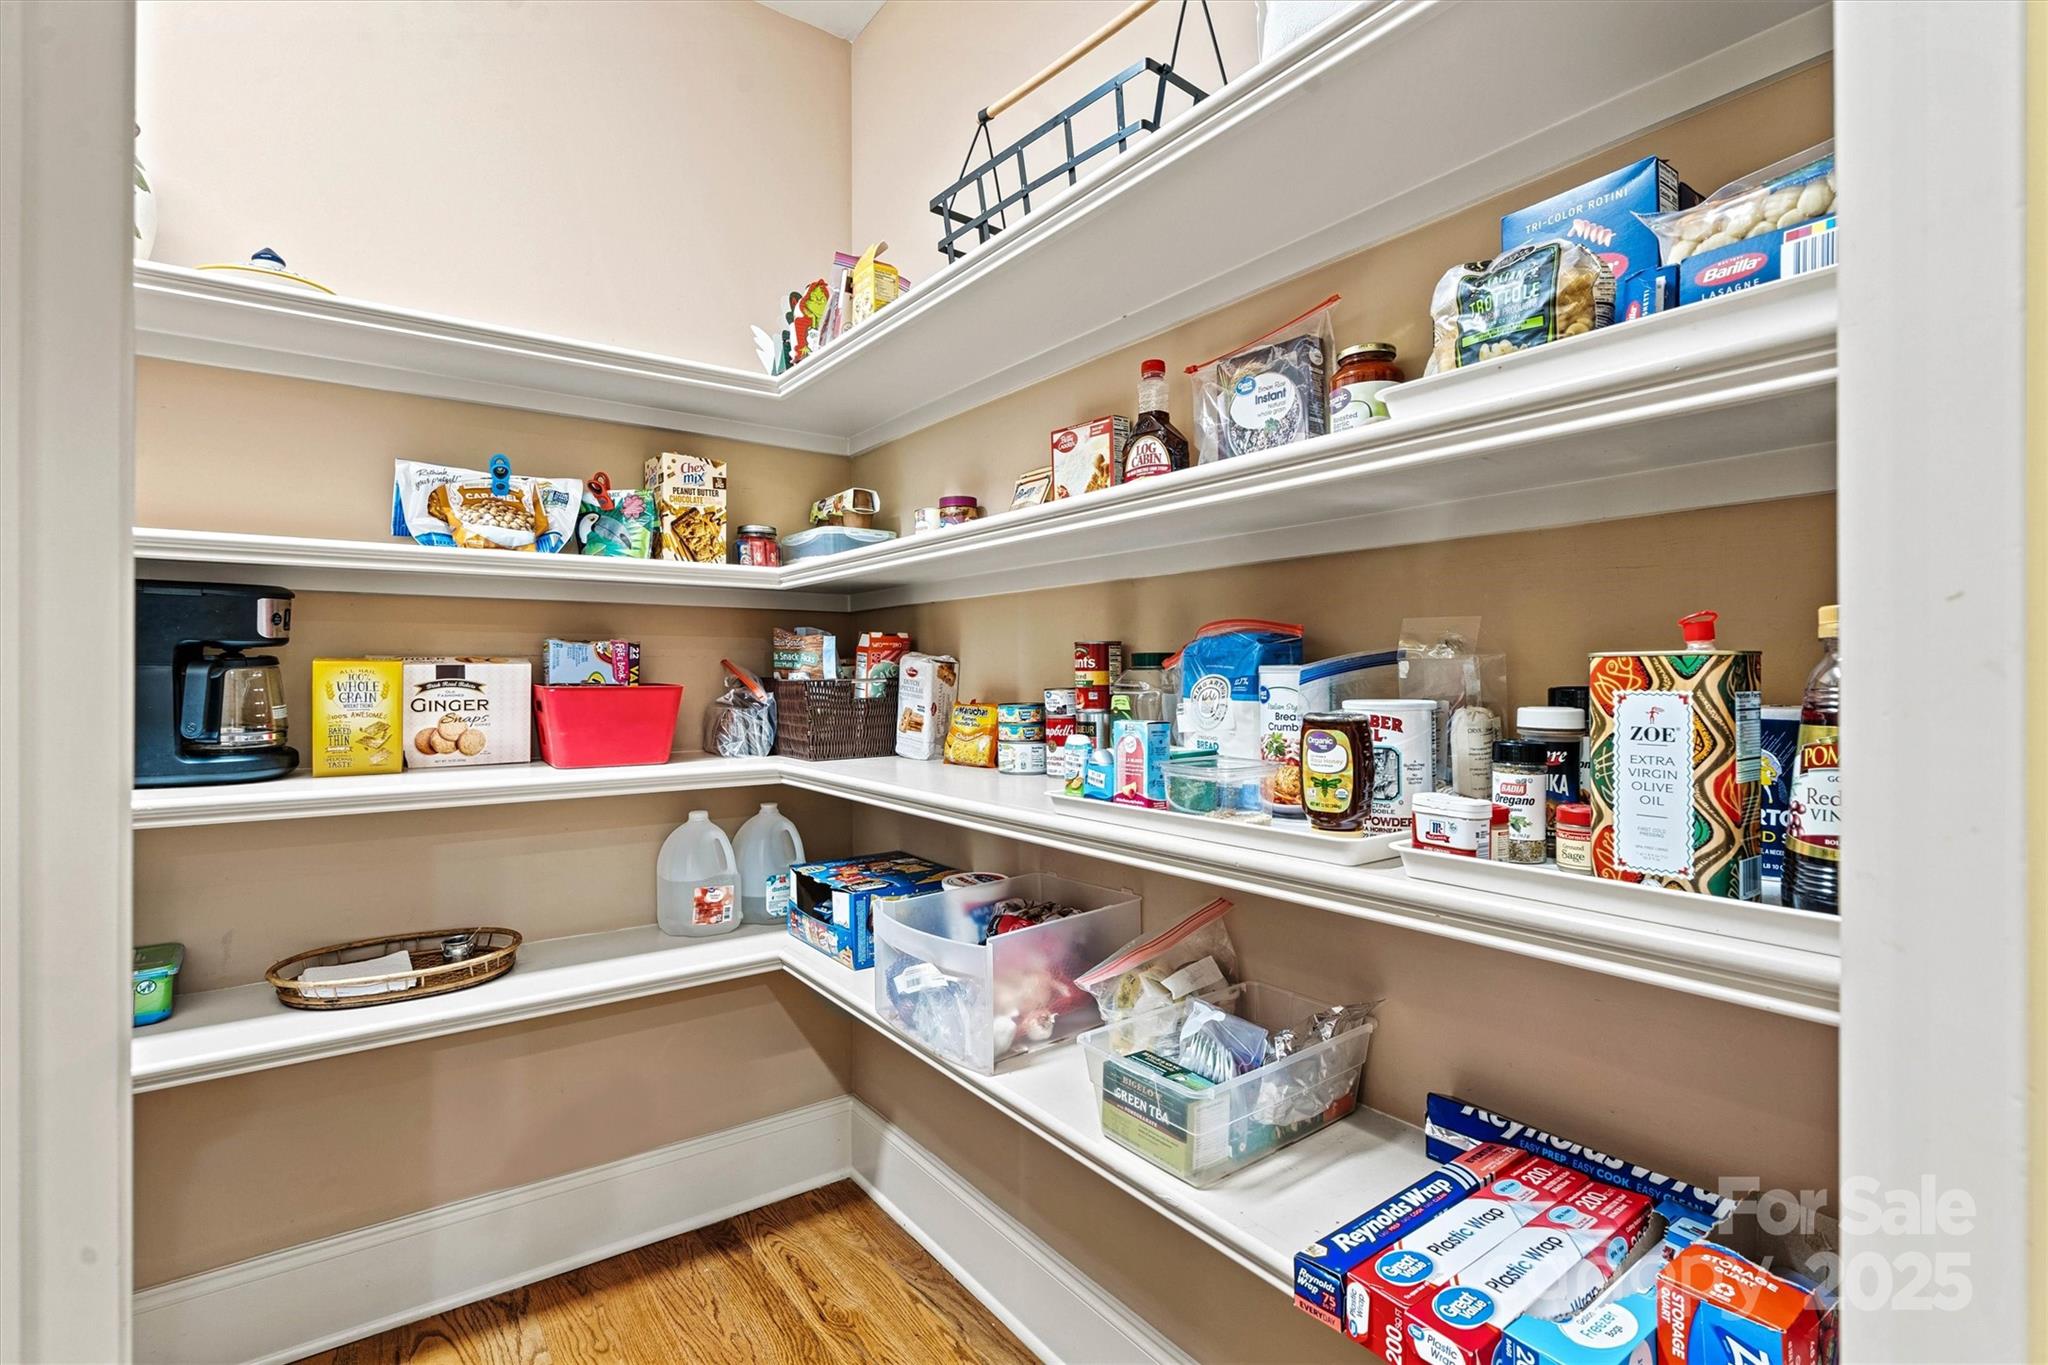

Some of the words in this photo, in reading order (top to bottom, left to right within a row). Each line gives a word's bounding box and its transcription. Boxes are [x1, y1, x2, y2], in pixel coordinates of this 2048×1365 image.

[1525, 204, 1583, 234] TRI-COLOR
[1588, 188, 1628, 210] ROTINI
[1703, 257, 1758, 284] Barilla
[1701, 277, 1760, 301] LASAGNE
[1255, 389, 1287, 405] Instant
[1136, 442, 1157, 456] LOG
[680, 462, 704, 474] Chex
[1131, 452, 1162, 468] CABIN
[683, 472, 704, 485] mix
[465, 492, 520, 503] CARAMEL
[669, 494, 704, 504] CHOCOLATE
[672, 486, 696, 496] PEANUT
[697, 487, 719, 498] BUTTER
[615, 643, 626, 660] FREE
[632, 647, 640, 660] 22
[780, 651, 800, 661] Snack
[348, 673, 371, 681] 100%
[336, 681, 380, 692] WHOLE
[338, 691, 377, 703] GRAIN
[410, 698, 490, 713] GINGER
[440, 712, 490, 727] Snaps
[328, 735, 350, 746] THIN
[1308, 735, 1333, 746] Organic
[1630, 726, 1676, 743] ZOE
[1196, 739, 1219, 750] BREAD
[1630, 754, 1676, 767] EXTRA
[1628, 767, 1678, 780] VIRGIN
[1501, 784, 1525, 794] BADIA
[1631, 781, 1674, 794] OLIVE
[1494, 792, 1536, 807] Oregano
[1639, 795, 1664, 806] OIL
[1363, 815, 1413, 828] POWDER
[1561, 851, 1586, 862] Sage
[1113, 1087, 1148, 1114] GREEN
[1519, 1139, 1540, 1154] EASY
[1572, 1158, 1595, 1174] EASY
[1636, 1182, 1662, 1200] EASY
[1521, 1167, 1553, 1185] 200
[1575, 1191, 1608, 1211] 200
[1331, 1200, 1409, 1254] Reynolds
[1399, 1178, 1453, 1208] Wrap
[1427, 1221, 1475, 1257] Plastic
[1467, 1206, 1505, 1234] Wrap
[1381, 1254, 1419, 1278] Great
[1399, 1262, 1427, 1279] Value
[1485, 1256, 1534, 1294] Plastic
[1525, 1234, 1563, 1264] Wrap
[1299, 1267, 1336, 1293] Reynolds
[1700, 1253, 1780, 1294] STORAGE
[1713, 1266, 1758, 1289] QUART
[1297, 1276, 1319, 1296] Wrap
[1322, 1292, 1336, 1307] 75
[1349, 1288, 1359, 1319] Plastic
[1357, 1293, 1366, 1319] Wrap
[1439, 1290, 1478, 1318] Great
[1660, 1287, 1670, 1324] QUART
[1299, 1301, 1336, 1325] EVERYDAY
[1461, 1298, 1488, 1320] Value
[1579, 1311, 1618, 1340] Freezer
[1604, 1325, 1624, 1338] Bags
[1671, 1291, 1685, 1360] STORAGE
[1385, 1324, 1403, 1365] 200
[1426, 1334, 1458, 1360] Plastic
[1430, 1347, 1457, 1365] Wrap
